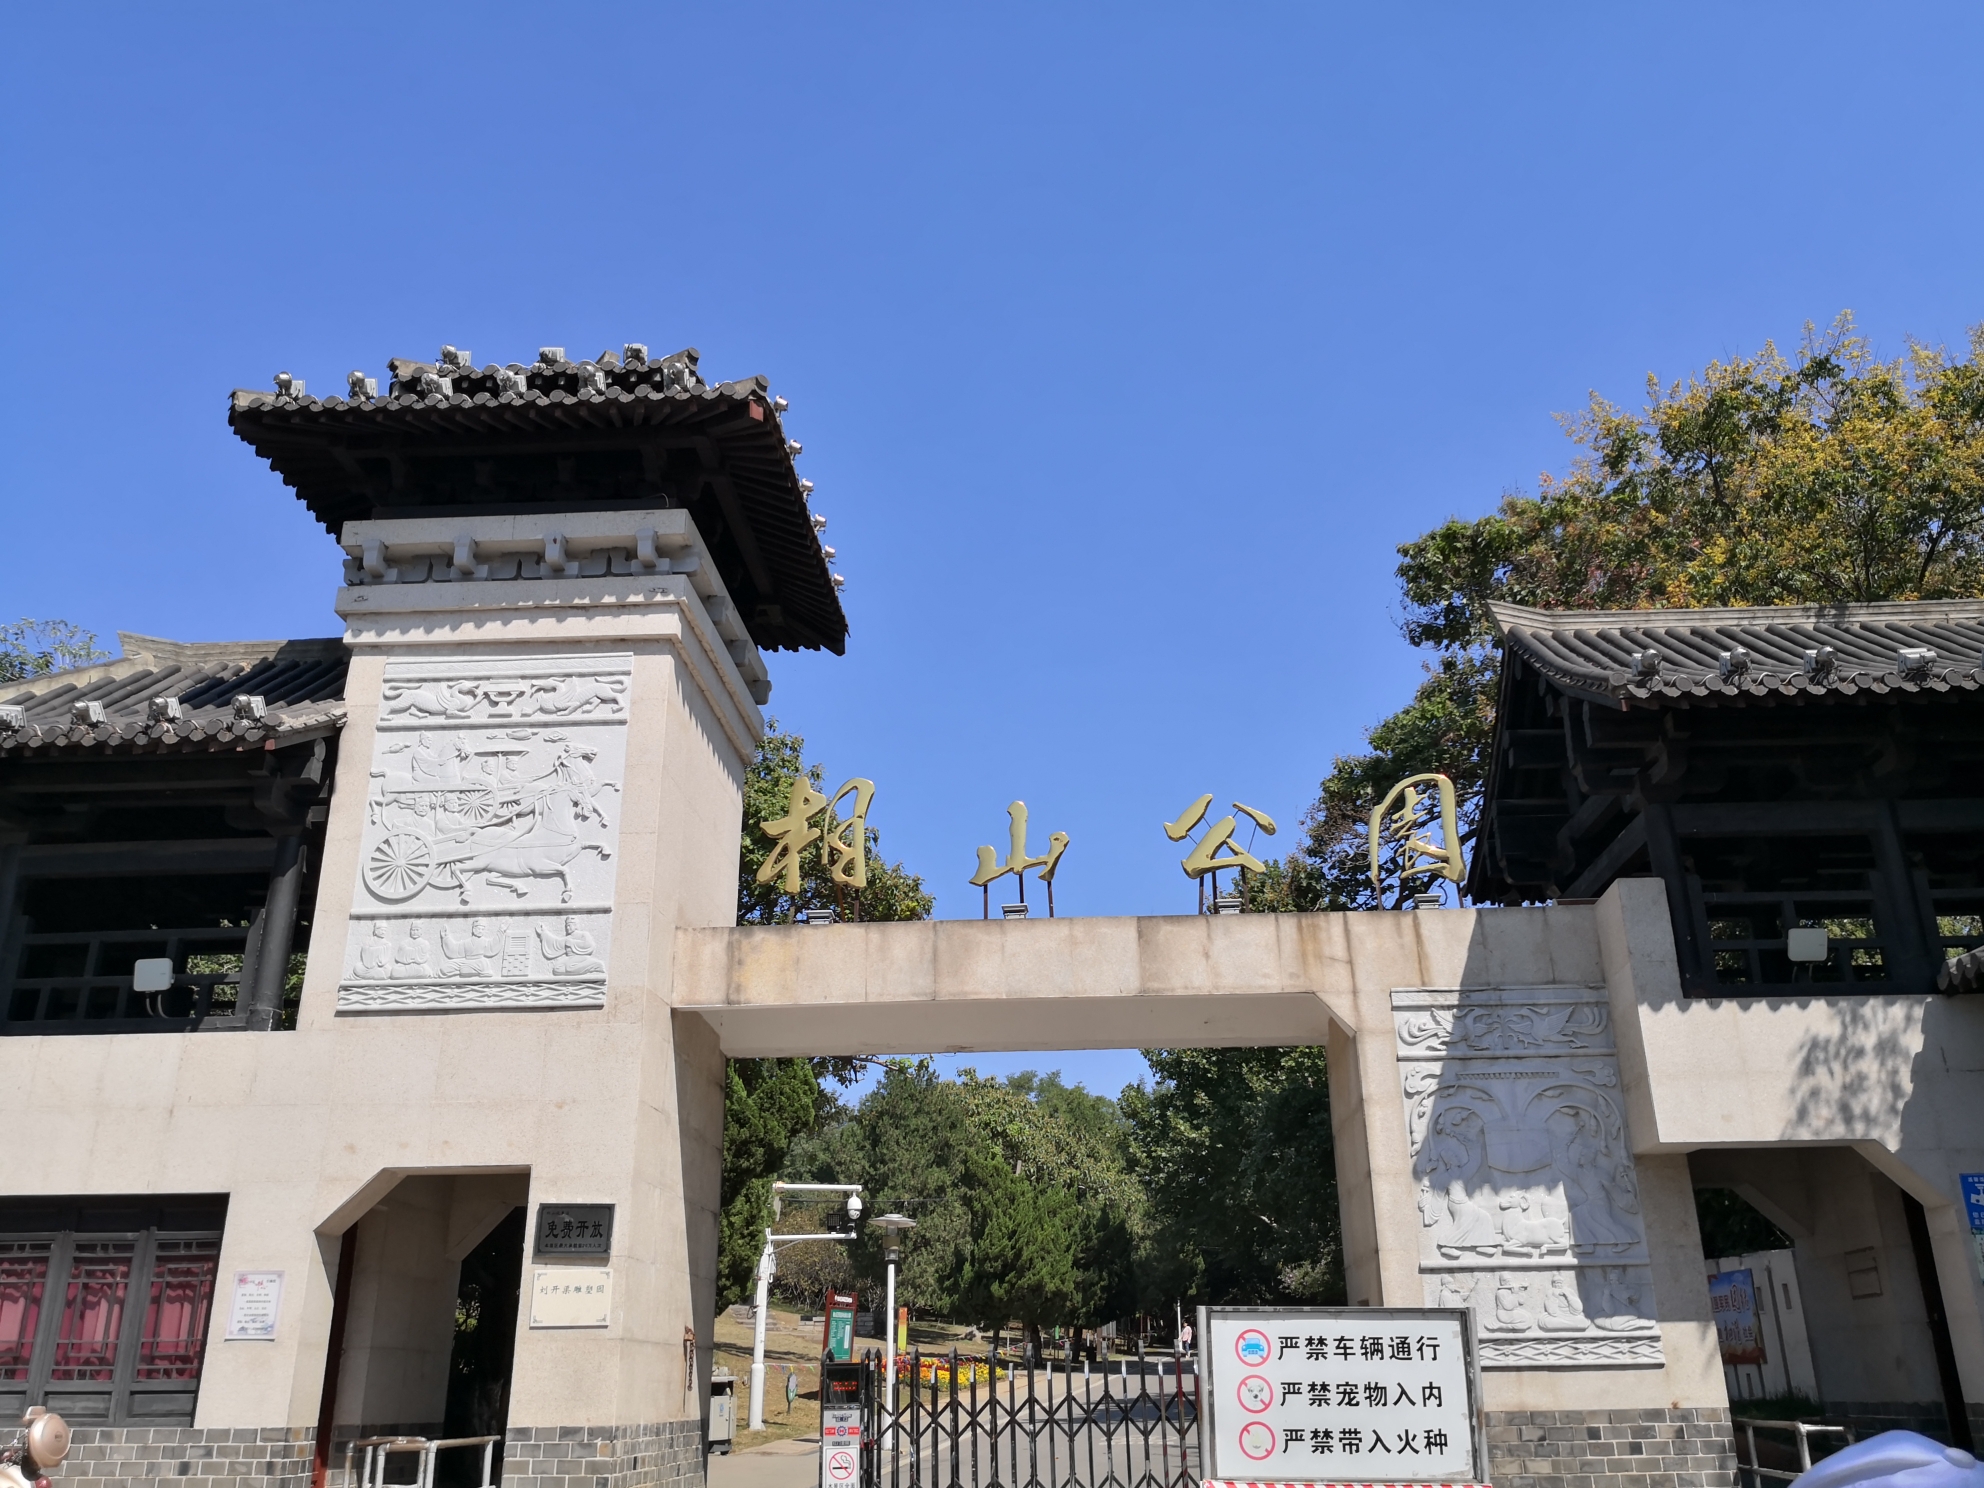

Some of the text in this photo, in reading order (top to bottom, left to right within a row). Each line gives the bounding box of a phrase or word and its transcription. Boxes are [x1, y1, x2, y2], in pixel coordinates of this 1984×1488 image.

[545, 1220, 603, 1239] 免费开放
[540, 1284, 605, 1295] 刘开渠雕塑园
[1278, 1335, 1441, 1361] 严禁车辆通行
[1280, 1381, 1444, 1408] 严禁宠物入内
[1282, 1427, 1449, 1455] 严禁带入火种
